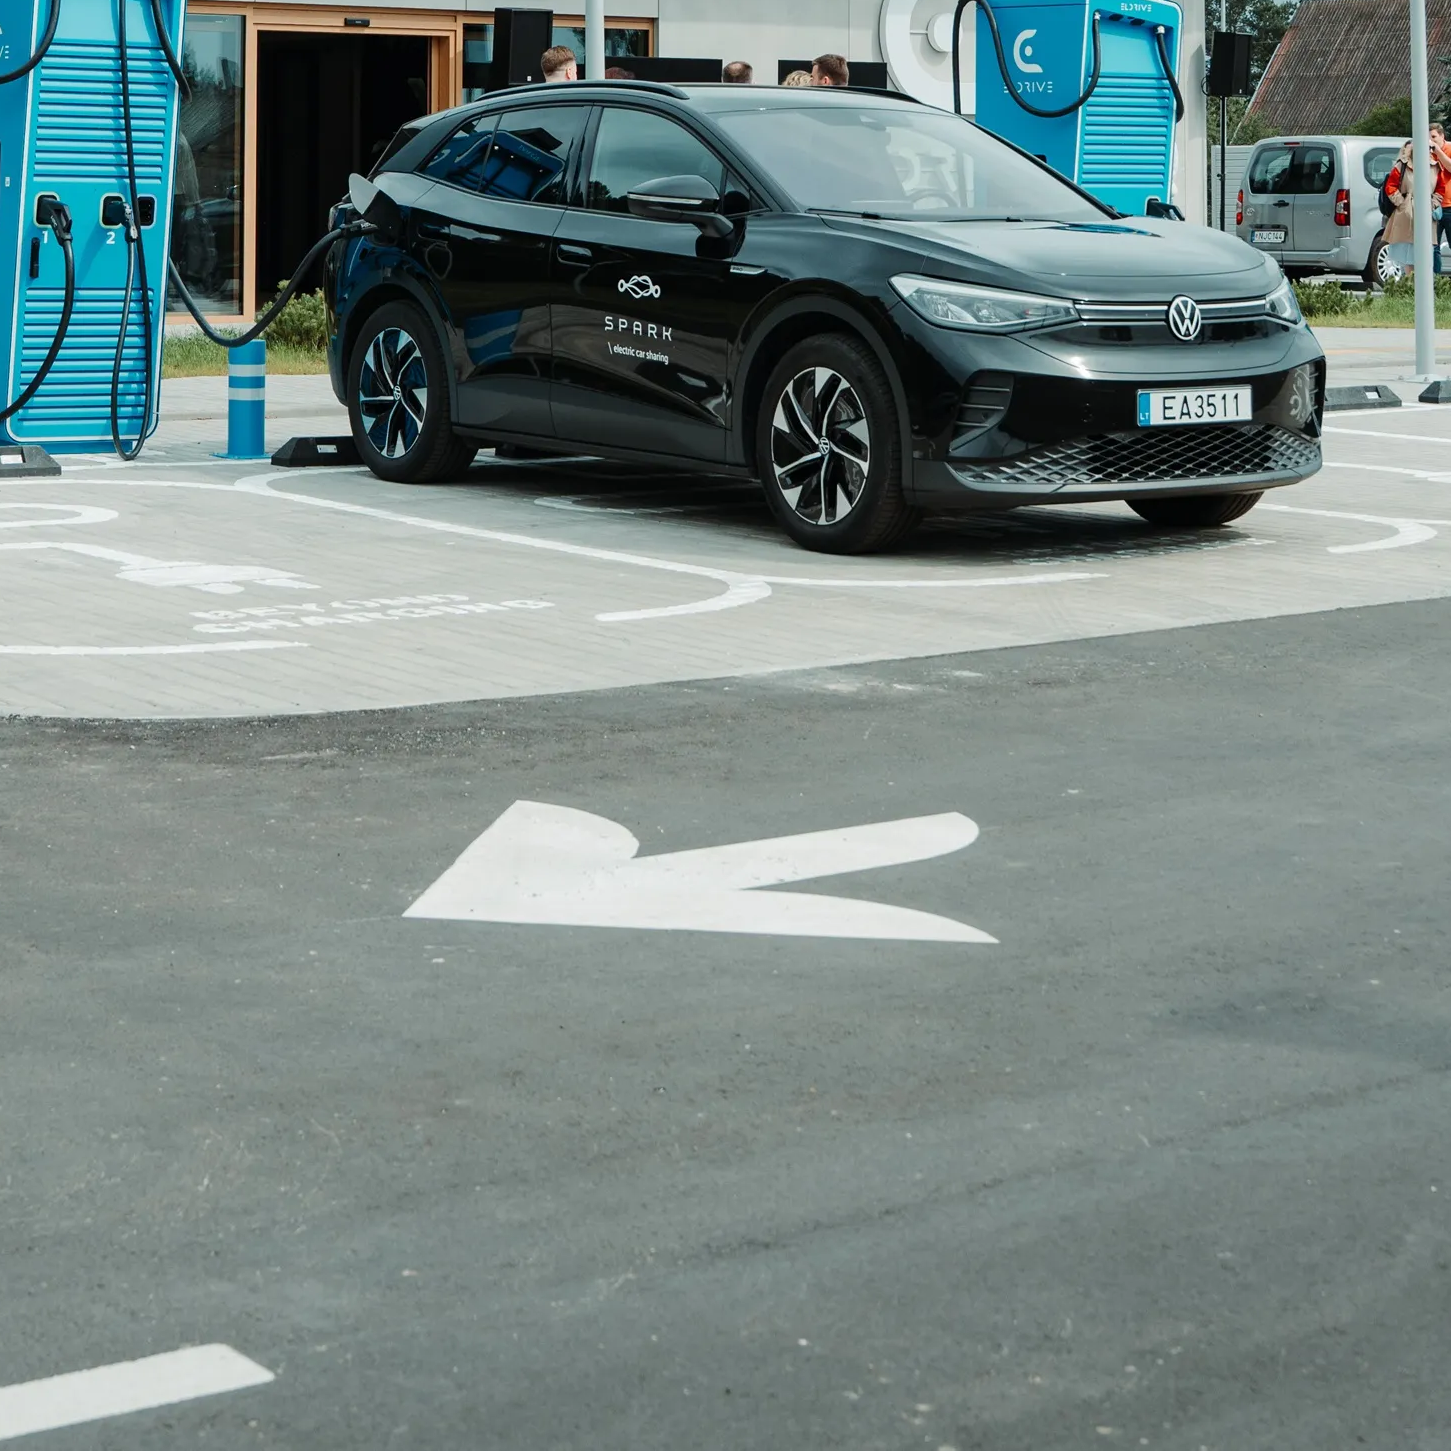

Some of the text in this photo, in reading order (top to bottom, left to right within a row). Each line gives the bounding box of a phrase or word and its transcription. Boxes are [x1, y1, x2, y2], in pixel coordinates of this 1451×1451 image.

[1120, 2, 1152, 12] ELDRIVE
[1004, 81, 1053, 93] EDRIVE
[42, 230, 49, 244] 1
[105, 231, 116, 245] 2
[604, 316, 673, 341] SPARK
[613, 343, 636, 357] electric
[635, 349, 646, 358] car
[646, 350, 669, 366] sharing
[1139, 392, 1240, 421] LT EA3511
